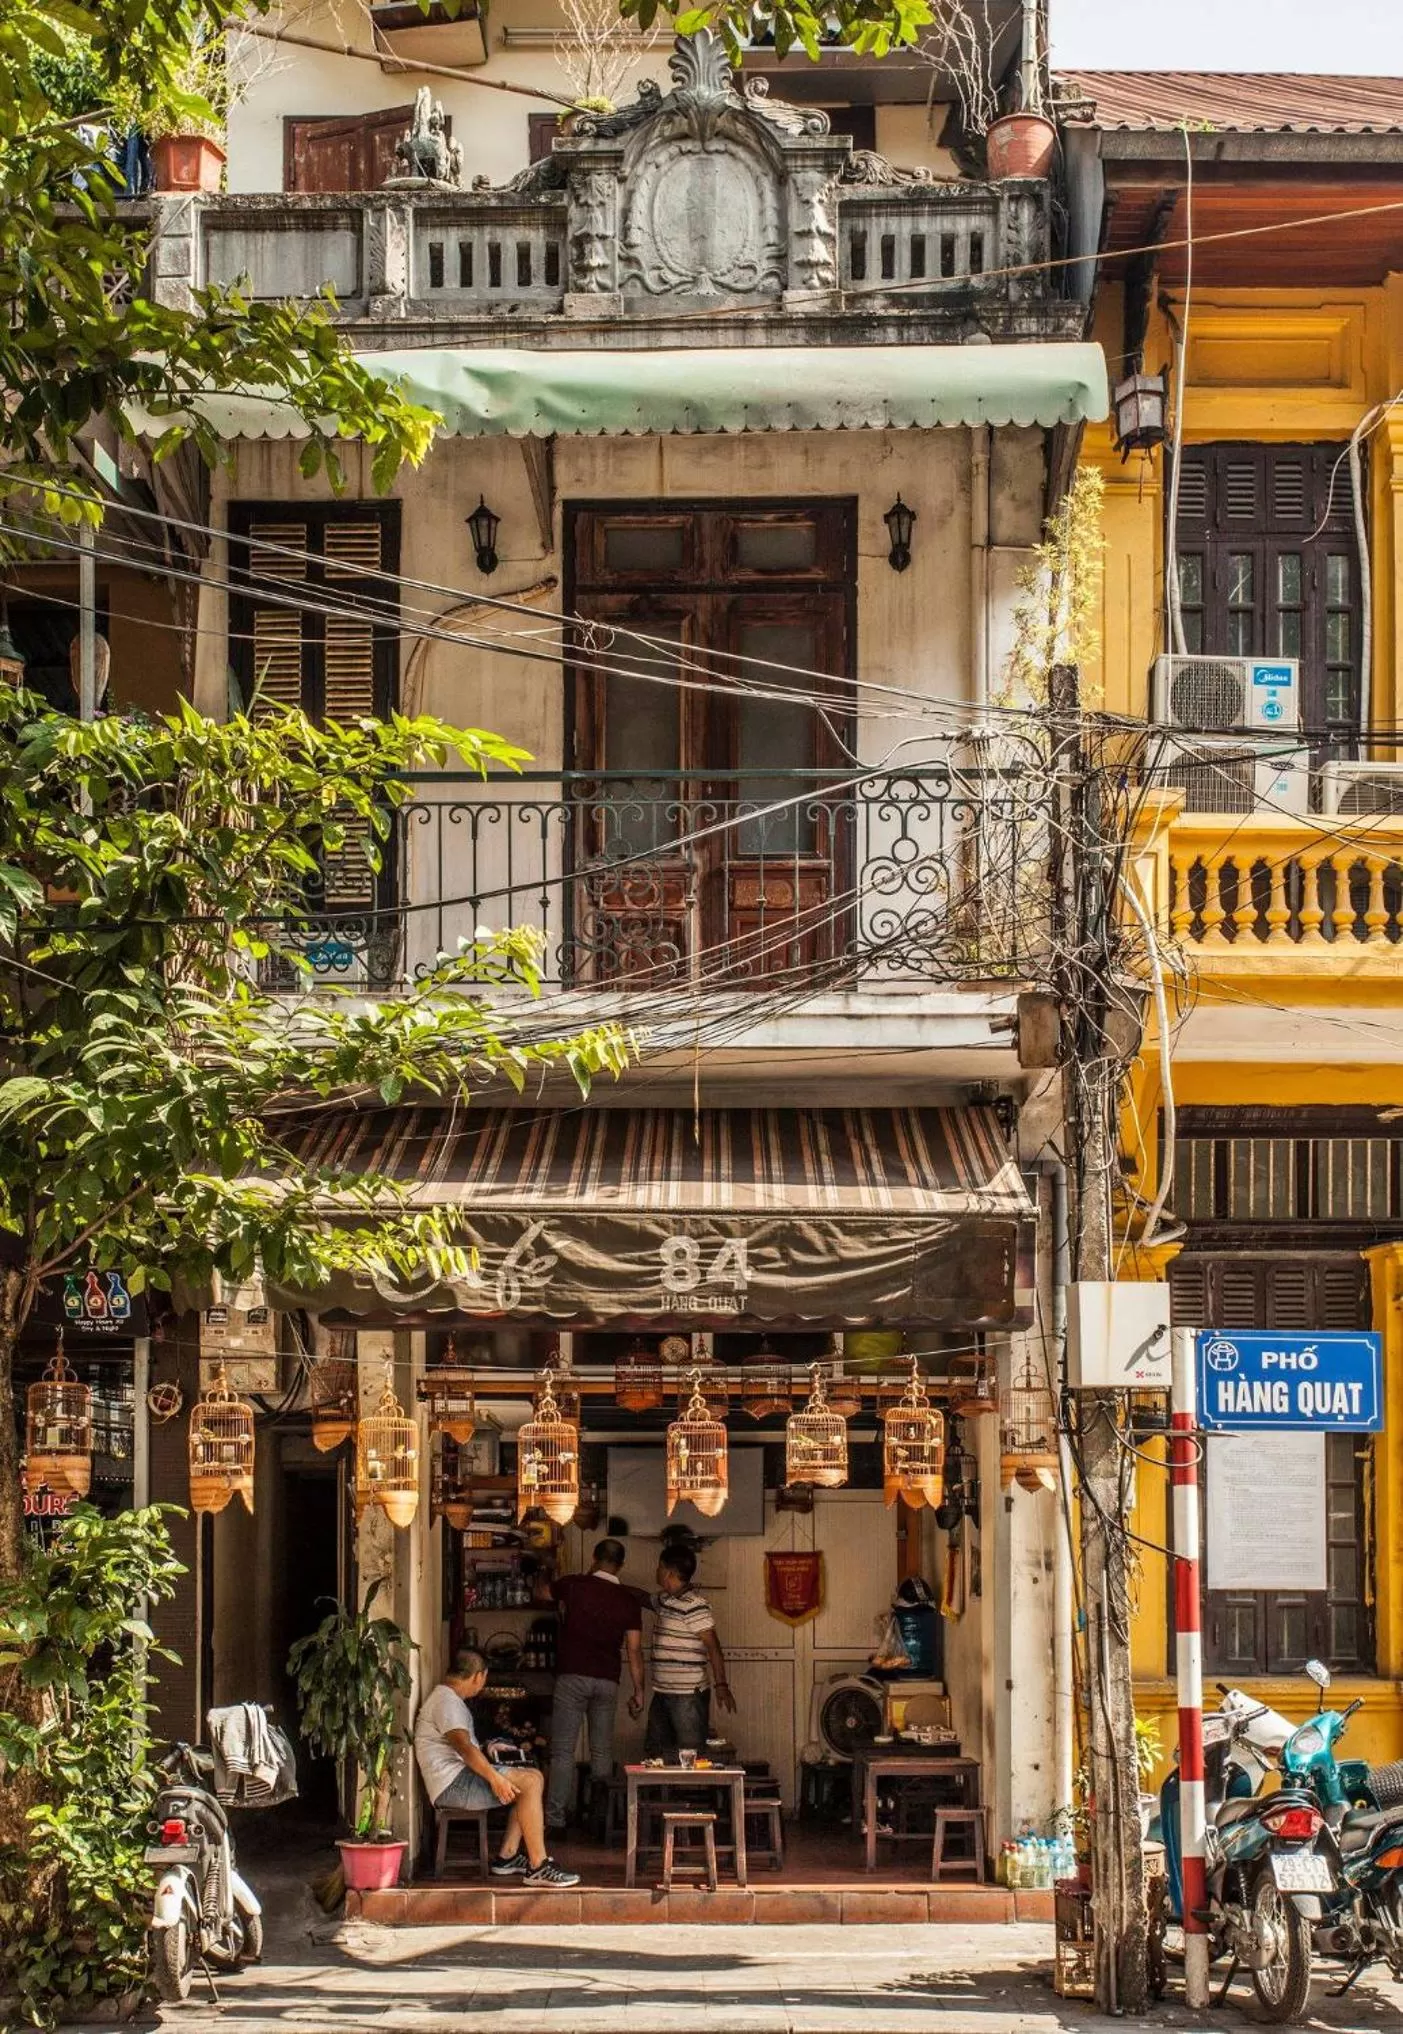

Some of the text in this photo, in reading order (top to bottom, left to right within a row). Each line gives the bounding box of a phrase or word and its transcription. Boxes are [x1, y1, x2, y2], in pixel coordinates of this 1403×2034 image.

[660, 1235, 752, 1292] 84
[1261, 1345, 1319, 1370] PHỐ
[1217, 1373, 1363, 1421] HÀNG QUẠT
